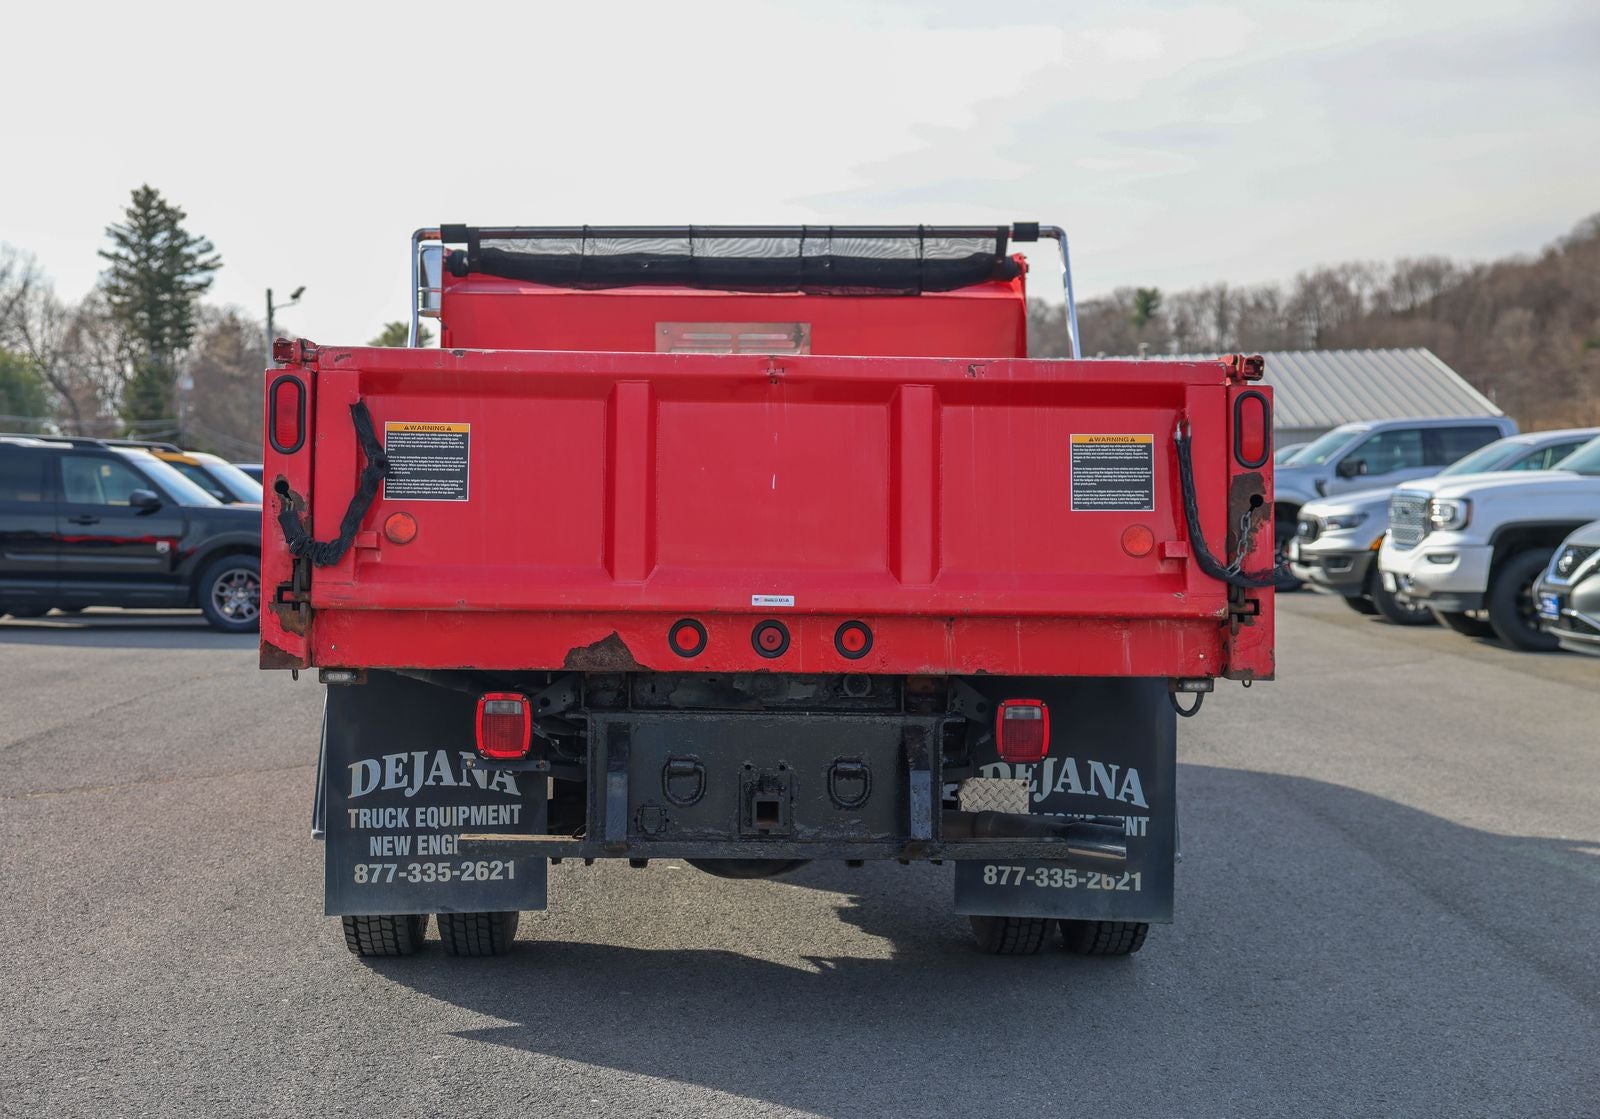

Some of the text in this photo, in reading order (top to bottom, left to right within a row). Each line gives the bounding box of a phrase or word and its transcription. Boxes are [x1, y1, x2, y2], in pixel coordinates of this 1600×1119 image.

[348, 750, 521, 799] DEJANA
[348, 804, 522, 829] TRUCK EQUIPMENT
[369, 835, 411, 857] NEW
[354, 860, 515, 884] 877-335-2621
[983, 865, 1142, 891] 877-335-2621
